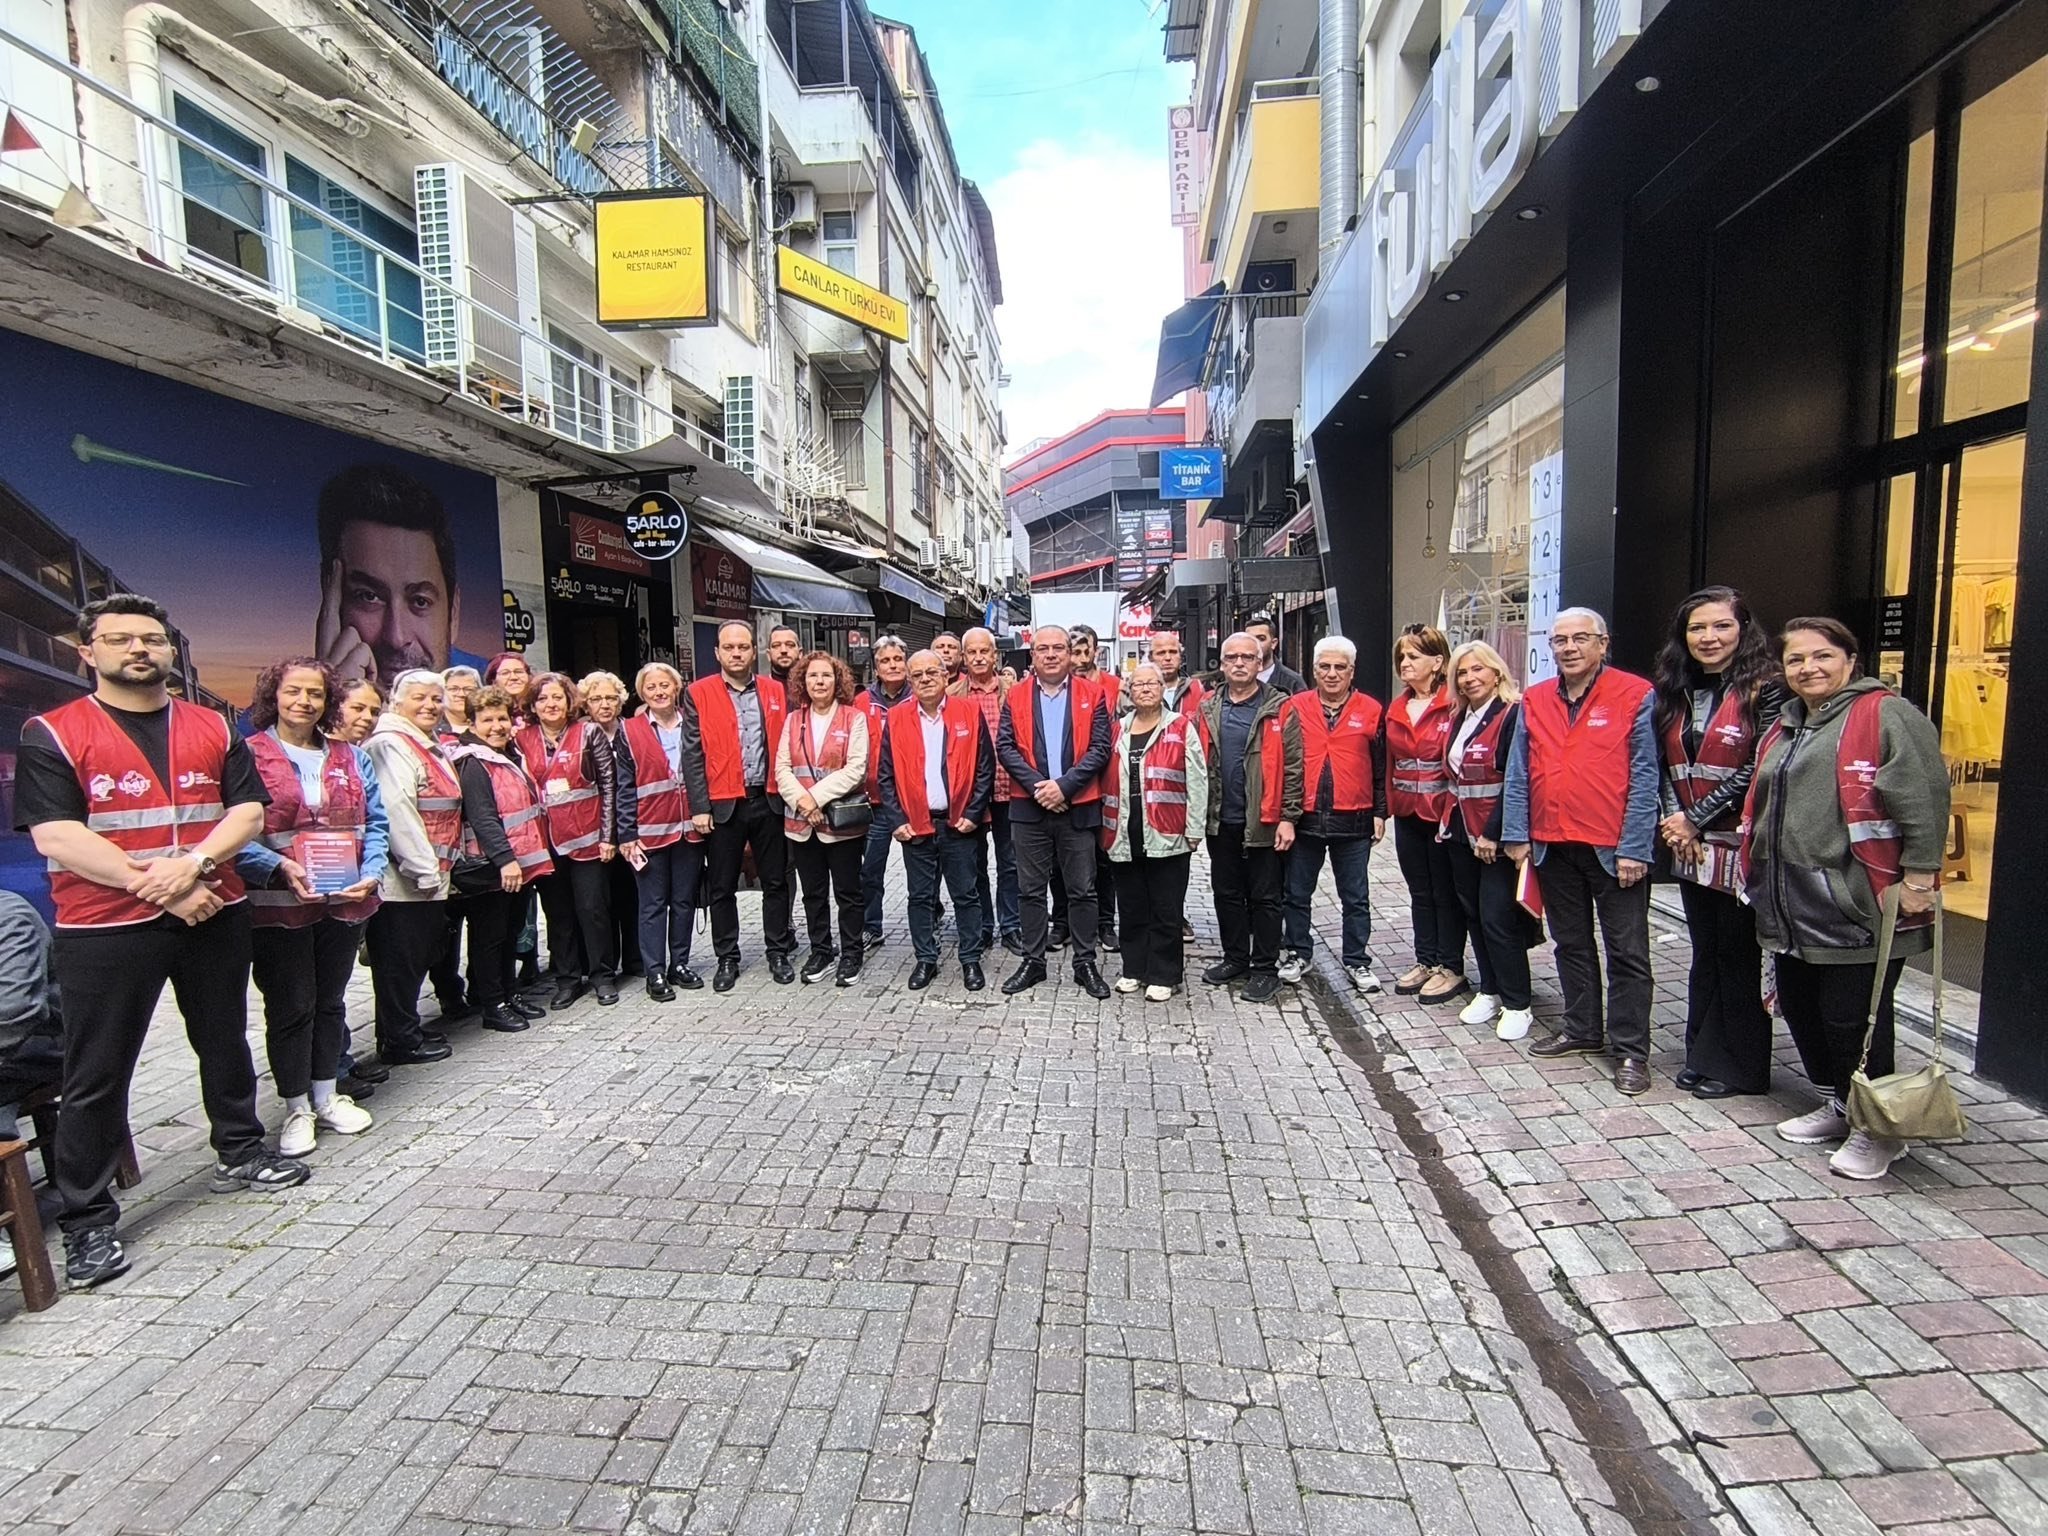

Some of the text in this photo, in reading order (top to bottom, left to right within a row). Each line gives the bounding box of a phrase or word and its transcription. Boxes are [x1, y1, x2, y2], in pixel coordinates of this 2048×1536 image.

[1174, 131, 1190, 158] DEM
[612, 249, 650, 259] KALAMAR
[626, 261, 677, 271] RESTAURANT
[793, 265, 840, 299] CANLAR
[842, 286, 878, 315] TÜRKÜ
[1172, 462, 1211, 475] TİTANİK
[1181, 476, 1202, 486] BAR
[1543, 471, 1551, 499] 3
[577, 545, 595, 559] CHP
[647, 539, 657, 547] bar
[1542, 531, 1550, 557] 2
[705, 577, 747, 600] KALAMAR
[1543, 593, 1549, 617] 1
